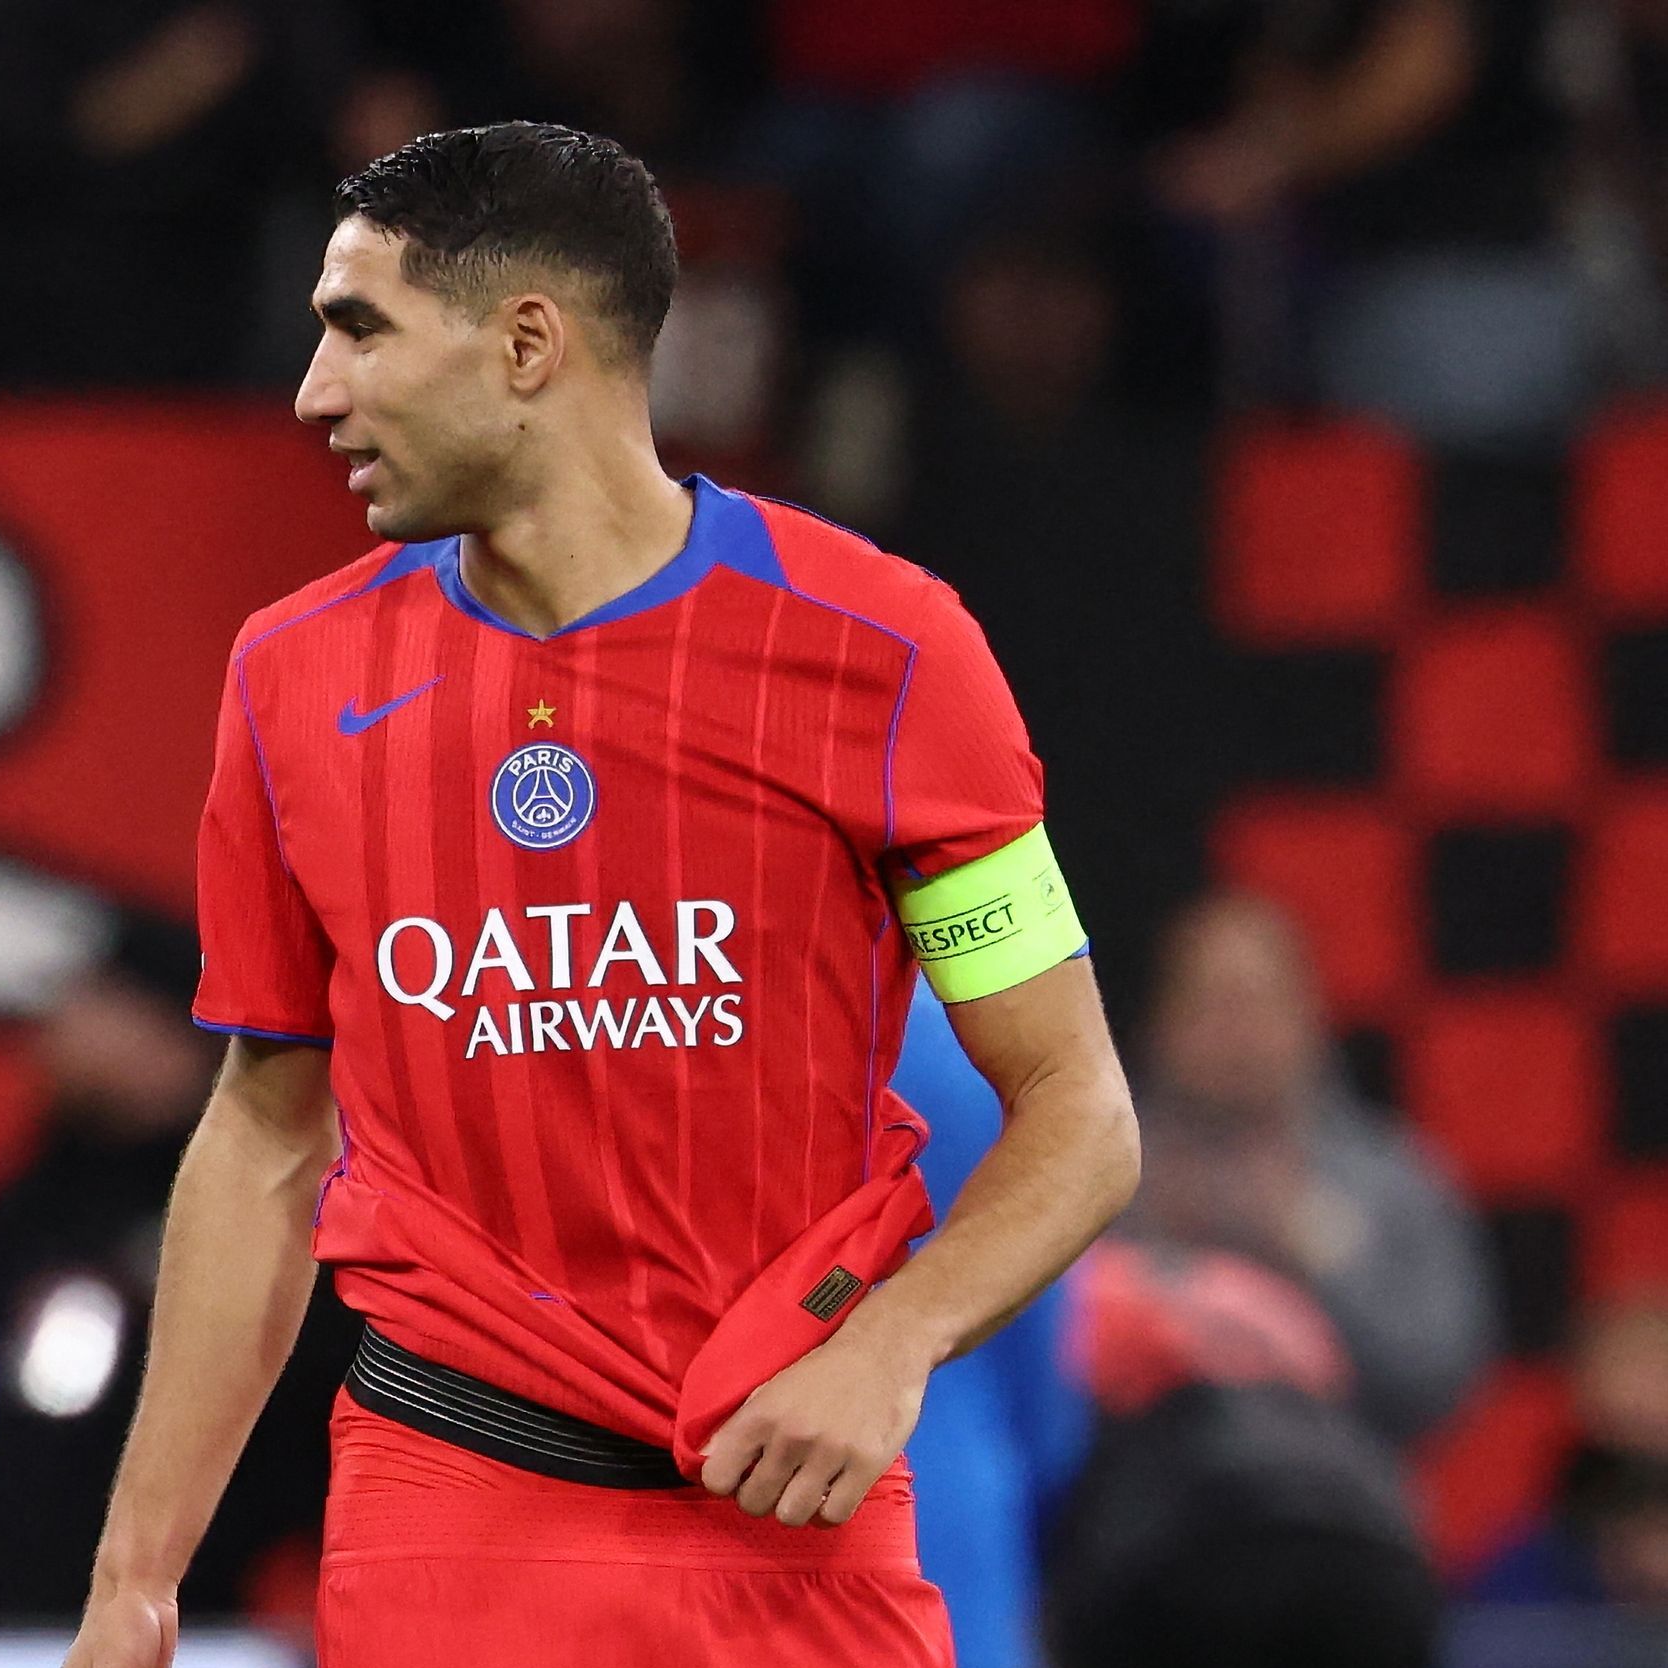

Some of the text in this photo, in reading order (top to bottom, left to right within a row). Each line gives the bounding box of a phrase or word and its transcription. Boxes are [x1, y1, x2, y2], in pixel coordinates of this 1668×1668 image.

[508, 750, 574, 776] PARIS
[377, 900, 743, 1021] QATAR
[465, 993, 743, 1059] AIRWAYS
